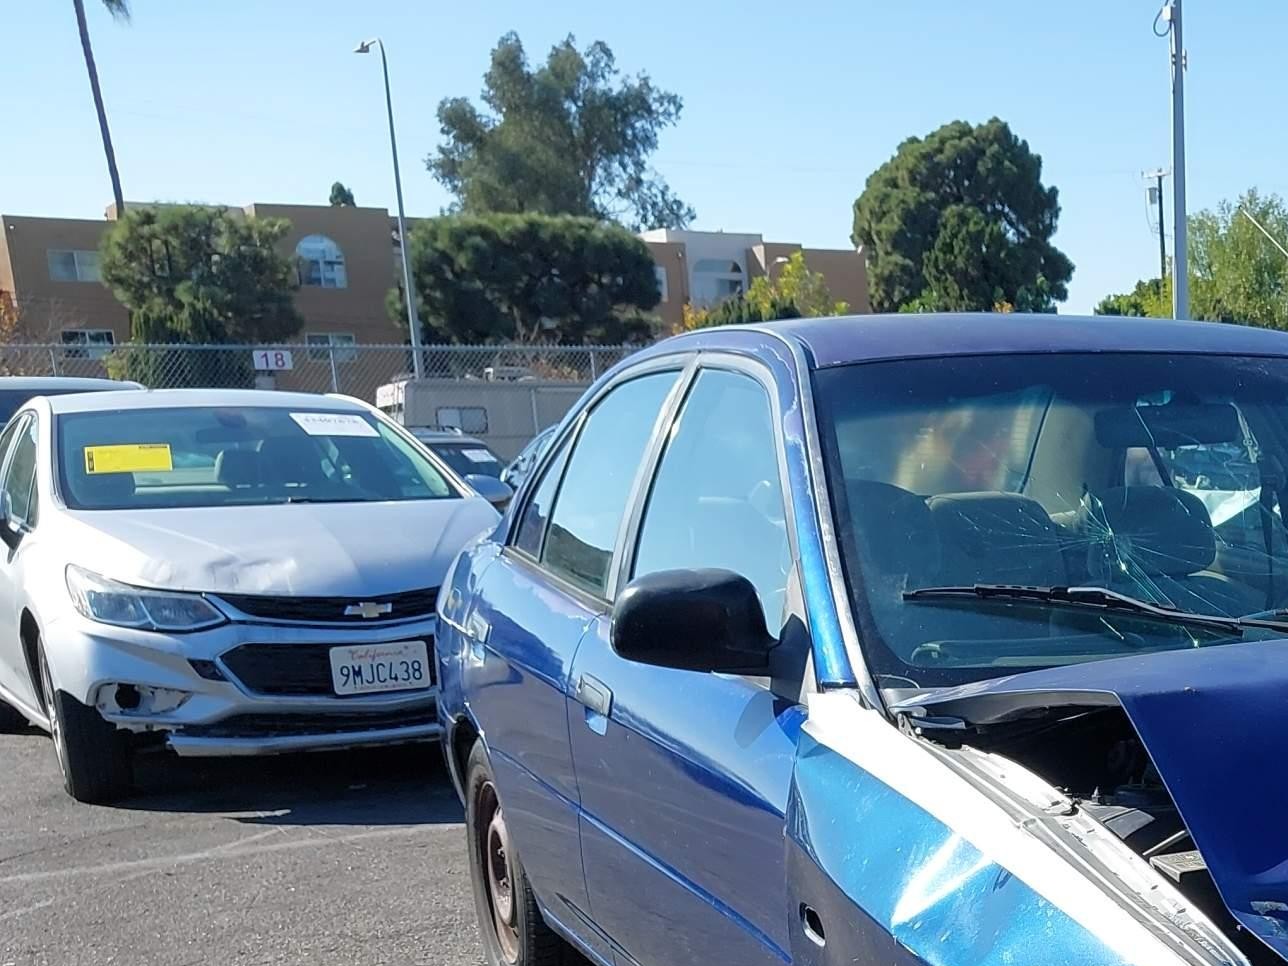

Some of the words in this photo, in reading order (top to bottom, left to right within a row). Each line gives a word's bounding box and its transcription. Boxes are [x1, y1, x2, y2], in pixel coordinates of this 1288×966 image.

[260, 351, 286, 369] 18
[351, 648, 404, 662] California
[339, 660, 423, 687] 9MJC438
